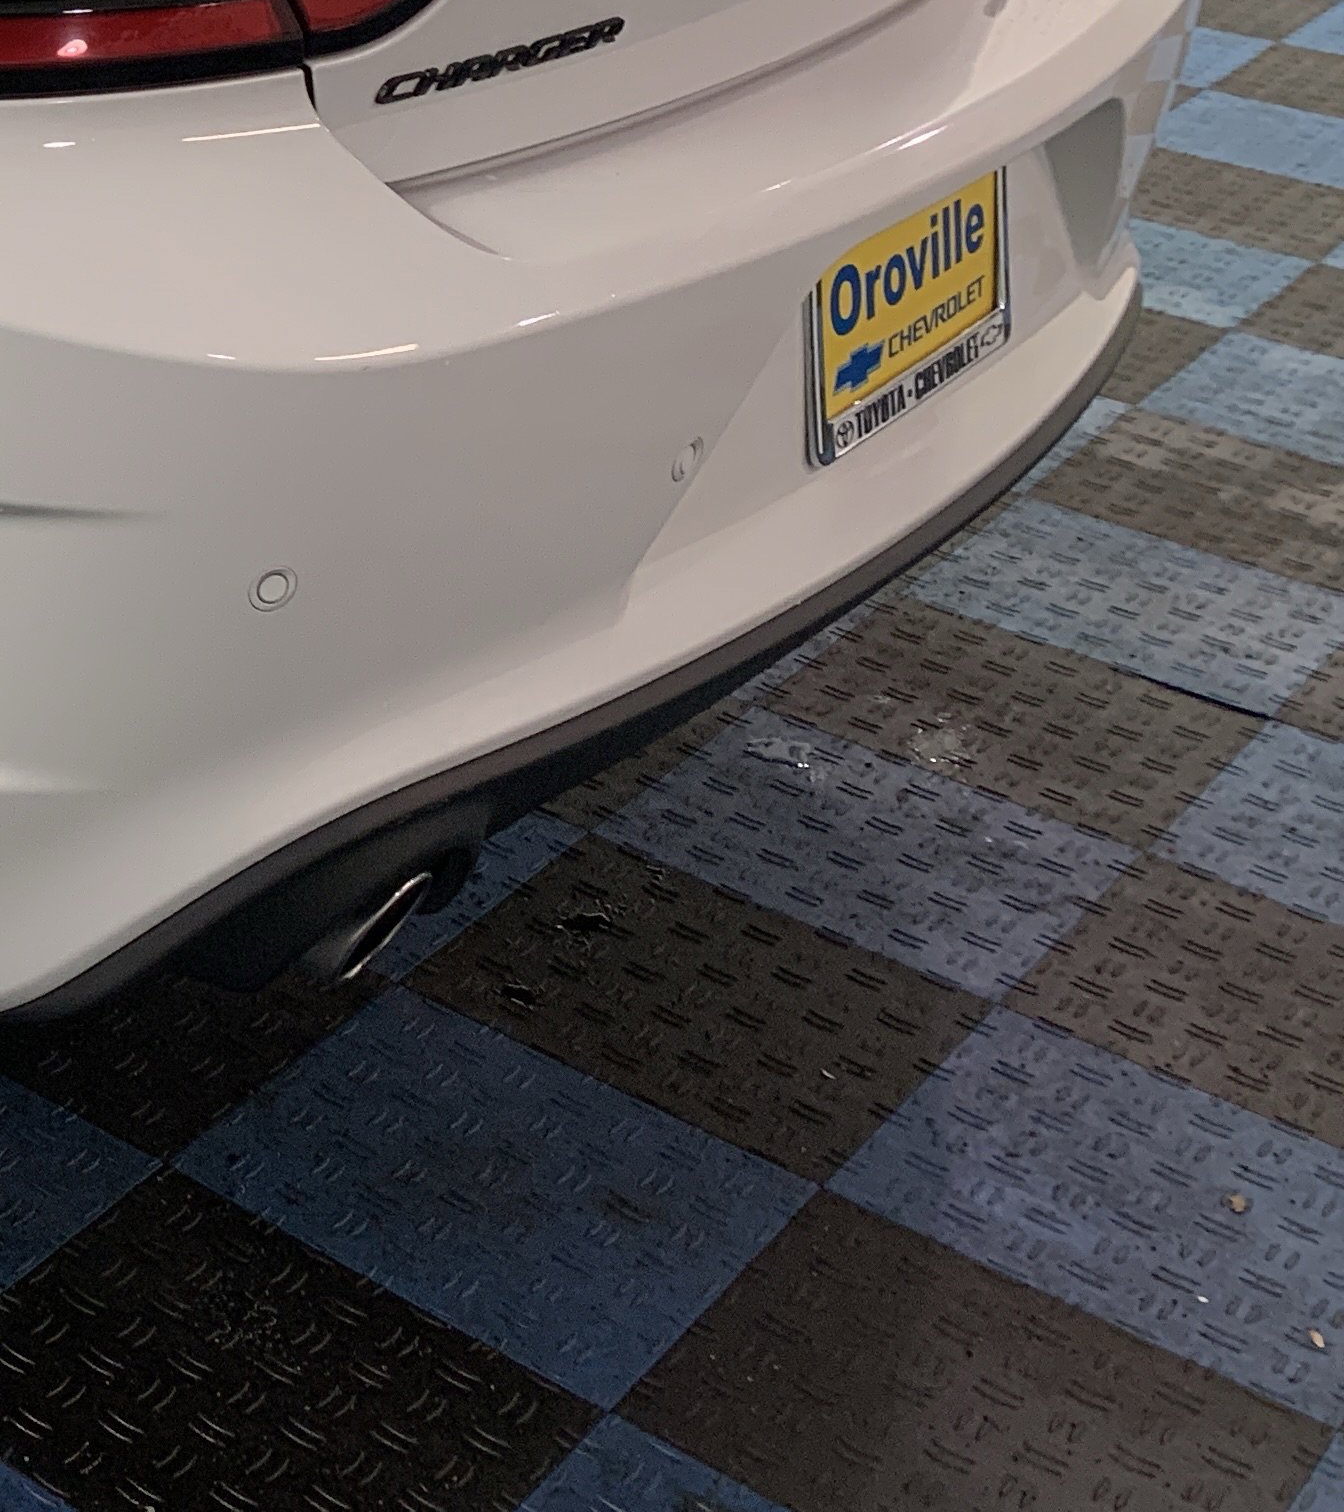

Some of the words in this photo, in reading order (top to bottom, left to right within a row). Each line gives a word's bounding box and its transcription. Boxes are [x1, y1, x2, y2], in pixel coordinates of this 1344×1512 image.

[374, 16, 625, 104] CHARGER
[830, 199, 985, 336] Oroville
[888, 275, 985, 358] CHEVROLET
[855, 384, 907, 439] TOYOTA
[914, 332, 979, 400] CHEVROLET
